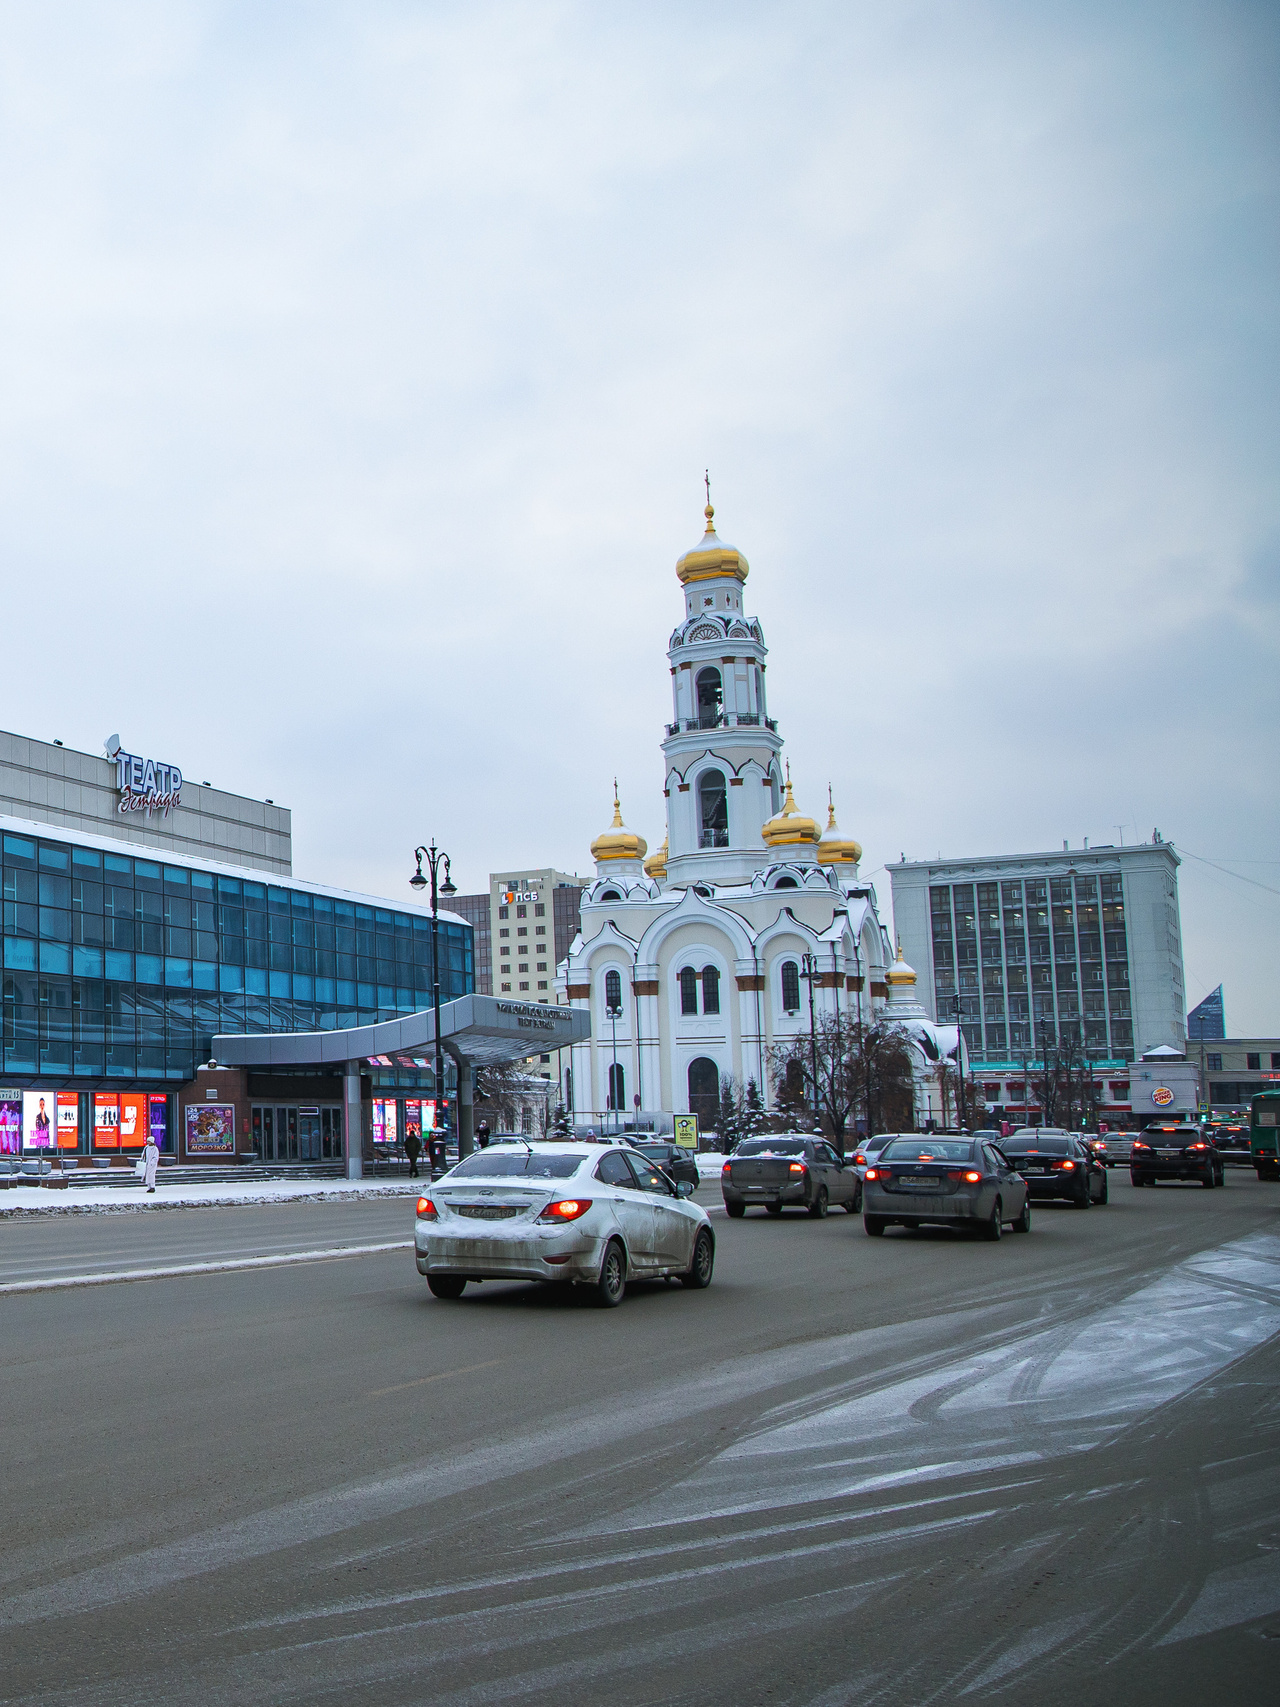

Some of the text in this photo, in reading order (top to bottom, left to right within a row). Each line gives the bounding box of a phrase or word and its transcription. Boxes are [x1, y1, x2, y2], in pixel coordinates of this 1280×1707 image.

[116, 752, 182, 797] ТЕАТР
[515, 892, 538, 902] ПСБ
[1153, 1090, 1170, 1098] BURGER
[1154, 1094, 1172, 1103] KING
